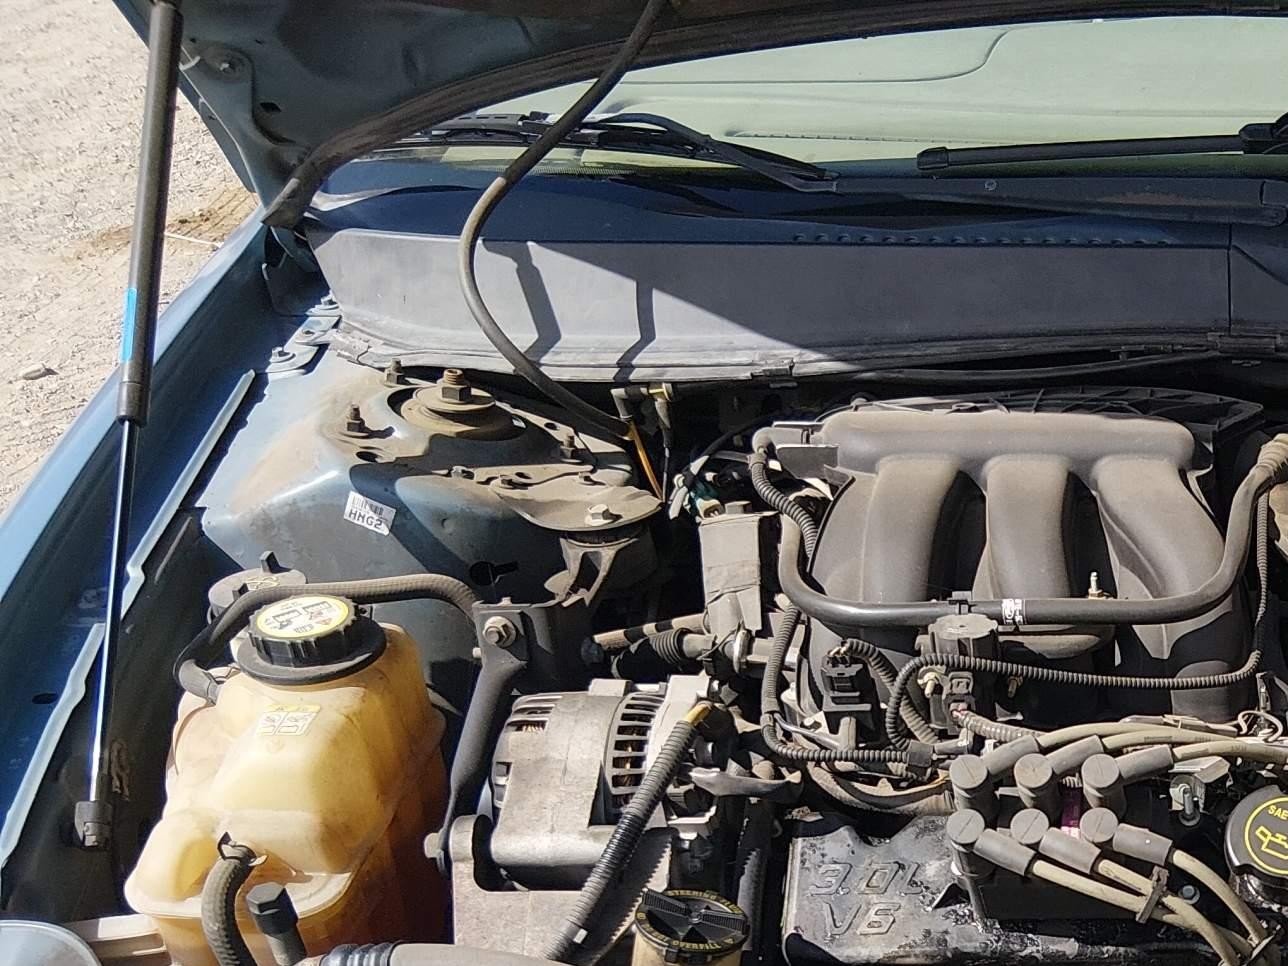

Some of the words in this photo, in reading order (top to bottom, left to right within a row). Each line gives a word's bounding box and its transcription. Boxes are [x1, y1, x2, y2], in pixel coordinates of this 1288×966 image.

[809, 860, 924, 896] 3.0L
[823, 900, 901, 936] V6
[671, 939, 722, 951] OVERFILL
